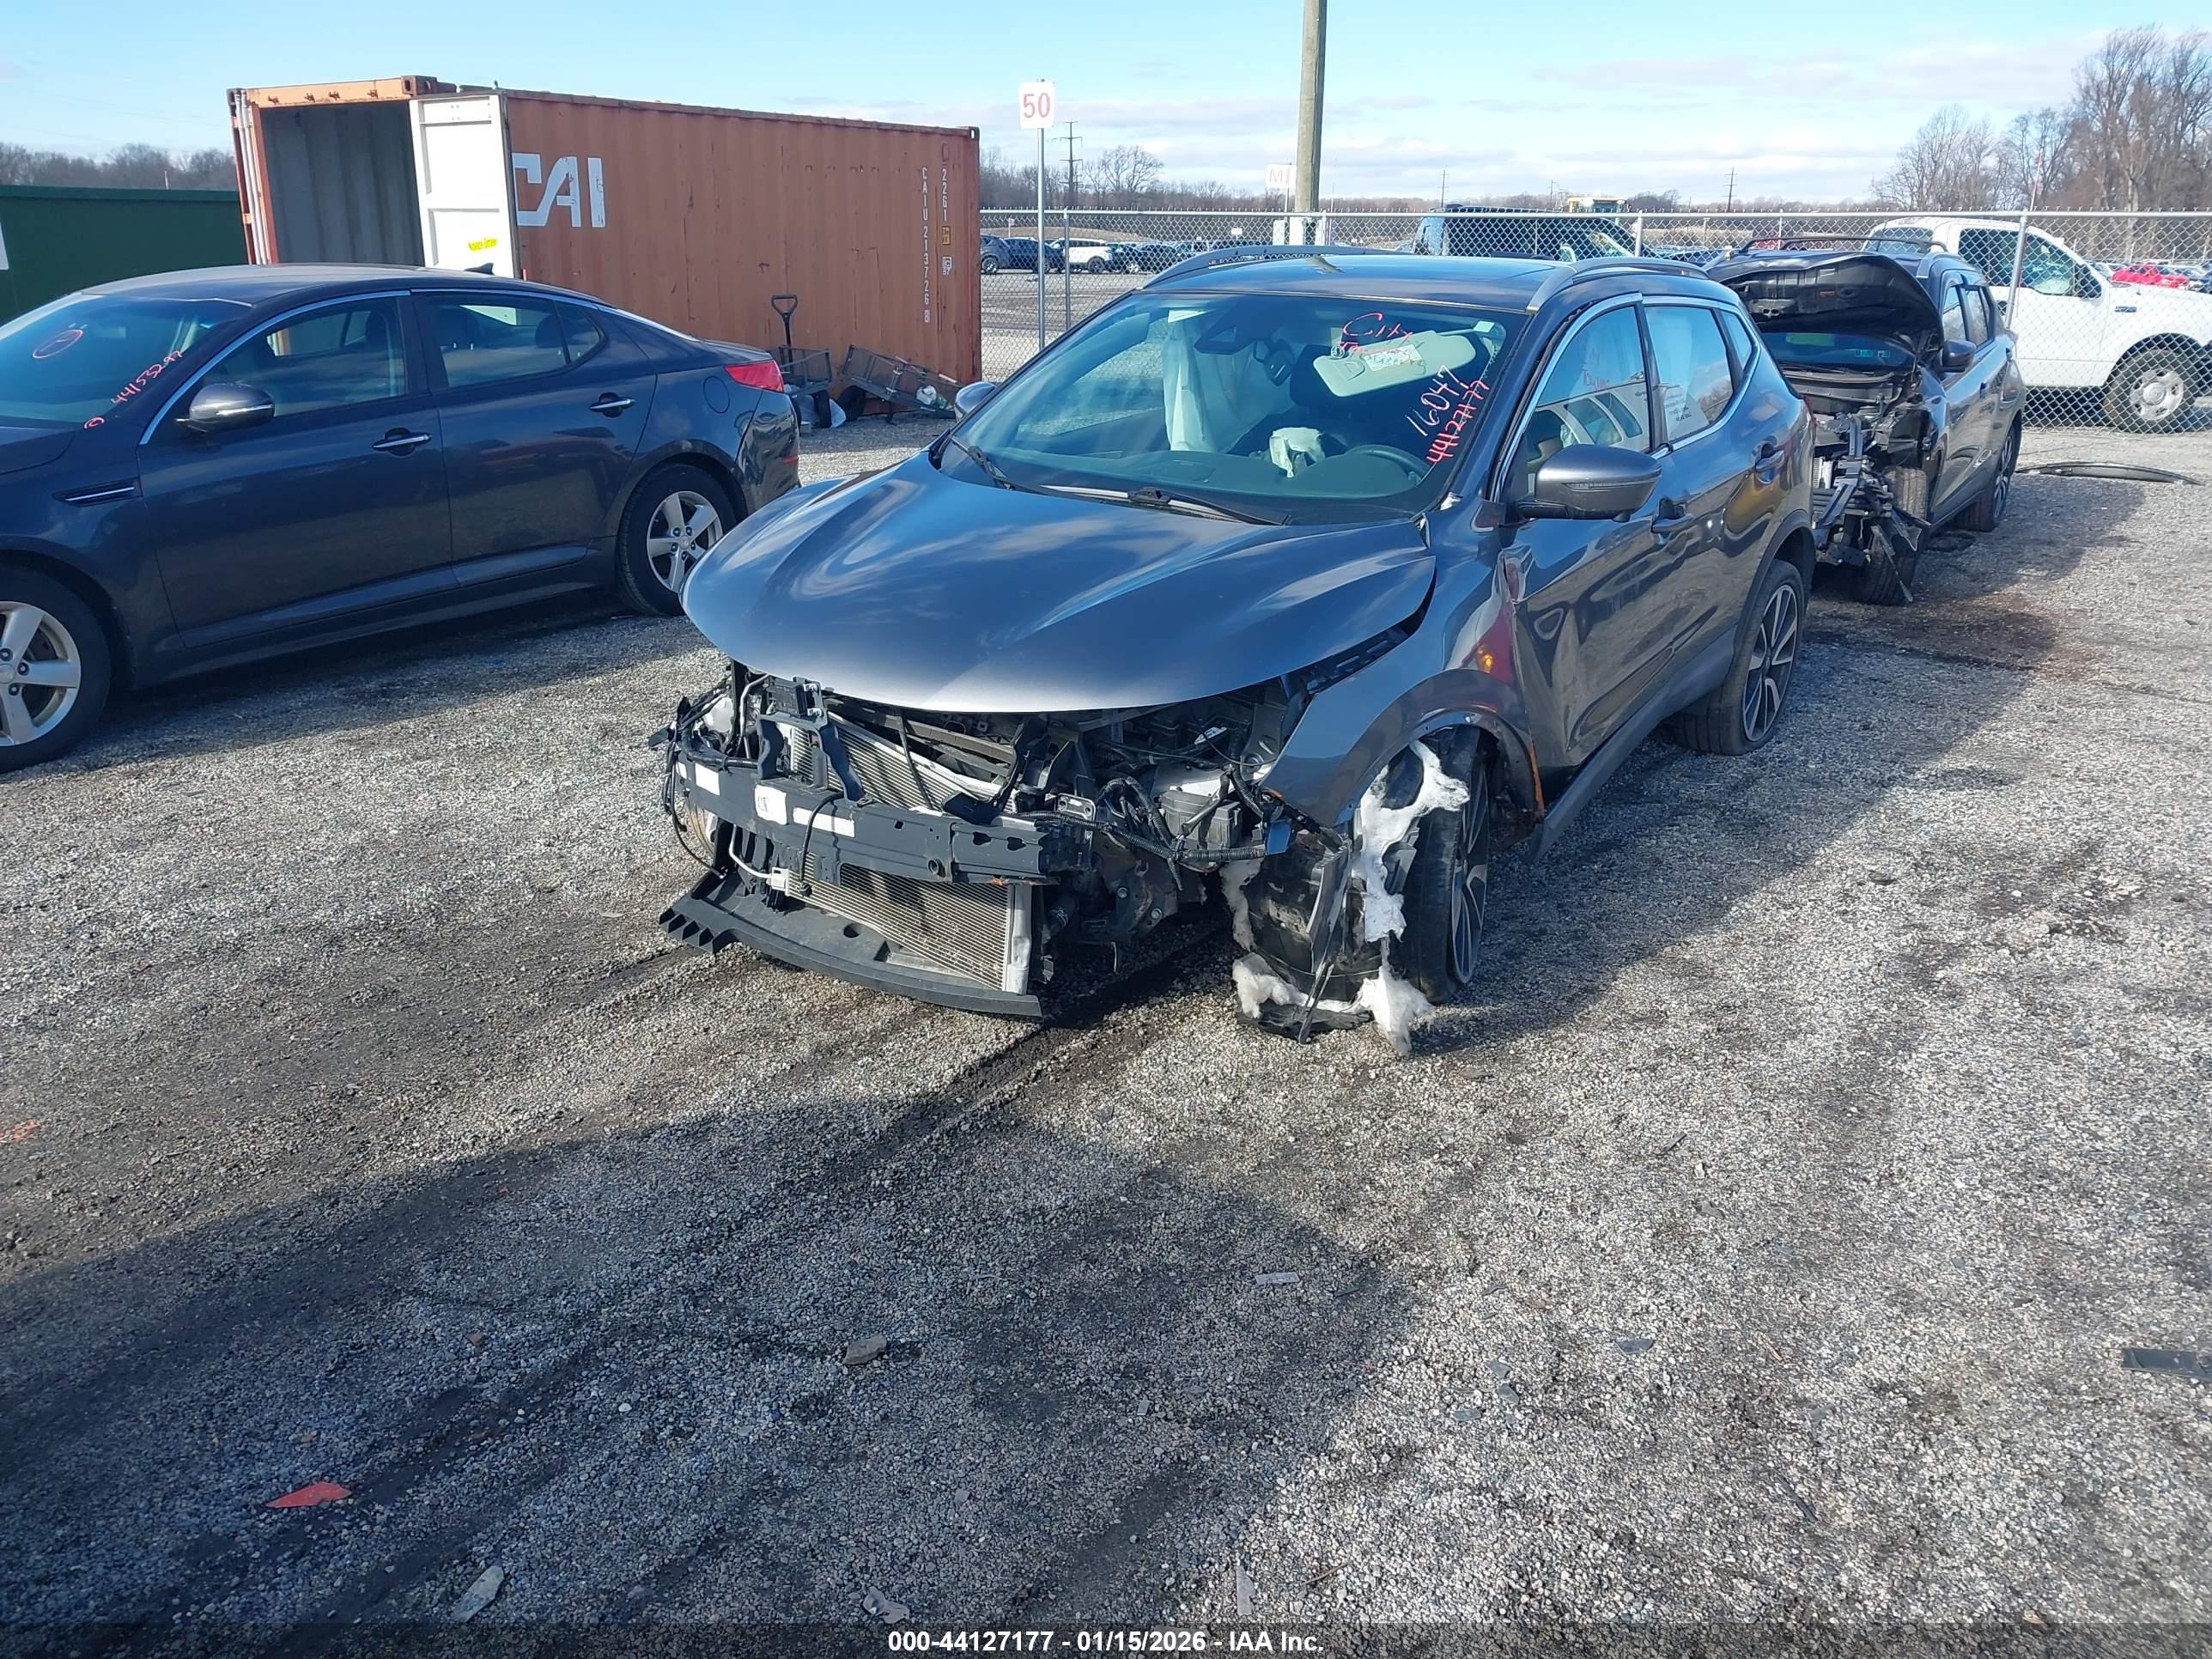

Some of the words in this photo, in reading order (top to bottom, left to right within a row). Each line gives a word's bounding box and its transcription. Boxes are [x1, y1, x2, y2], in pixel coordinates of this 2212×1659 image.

[1023, 93, 1050, 118] 50
[512, 153, 605, 228] CAI
[1404, 364, 1470, 436] 16047
